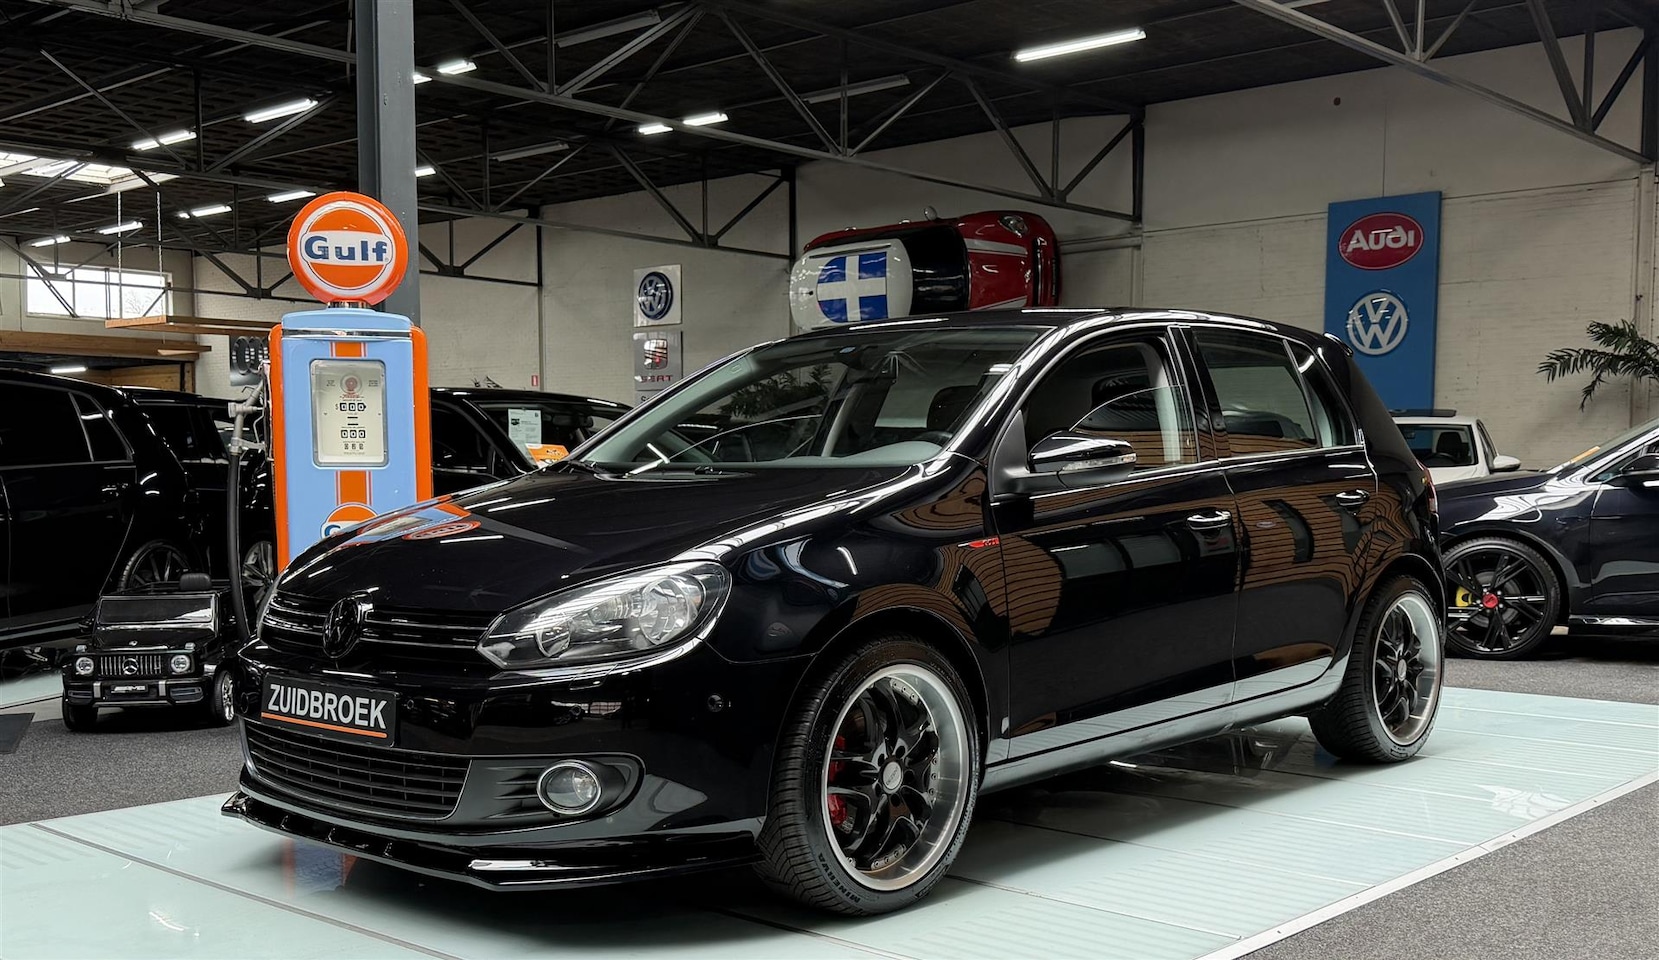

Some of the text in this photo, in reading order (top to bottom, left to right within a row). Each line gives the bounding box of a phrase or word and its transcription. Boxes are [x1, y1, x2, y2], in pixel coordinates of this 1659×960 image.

[304, 235, 388, 262] Gulf
[268, 683, 387, 729] ZUIDBROEK
[818, 852, 861, 903] MINERVA
